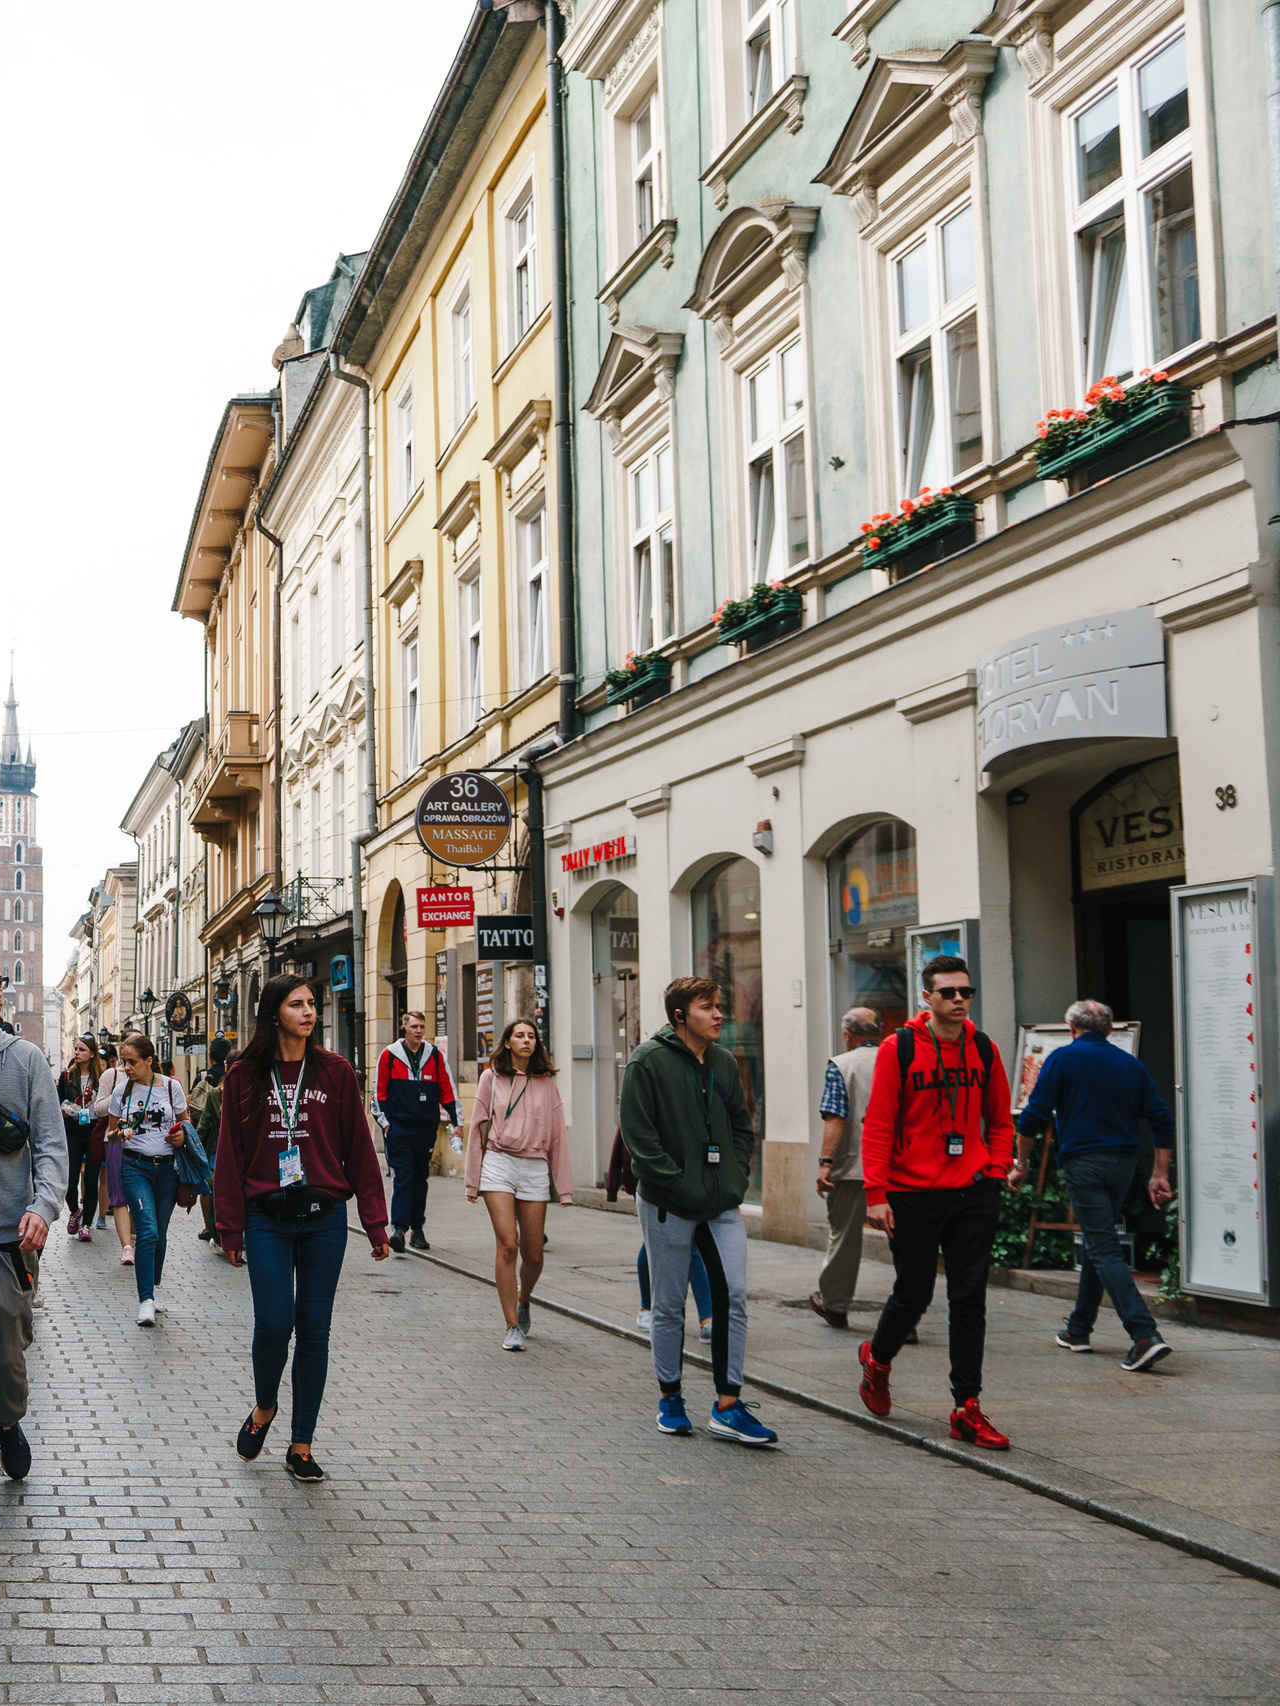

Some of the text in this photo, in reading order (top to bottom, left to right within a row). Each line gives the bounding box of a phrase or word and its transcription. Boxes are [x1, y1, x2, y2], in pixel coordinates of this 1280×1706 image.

[449, 777, 479, 798] 36
[1214, 784, 1237, 811] 38
[426, 801, 503, 812] ART GALLERY
[423, 813, 506, 823] OPRAWA OBRAZÓW
[432, 828, 497, 840] MASSAGE
[445, 844, 483, 854] ThaiBali
[561, 846, 590, 873] TALLY
[421, 892, 471, 903] KANTOR
[422, 911, 472, 922] EXCHANGE
